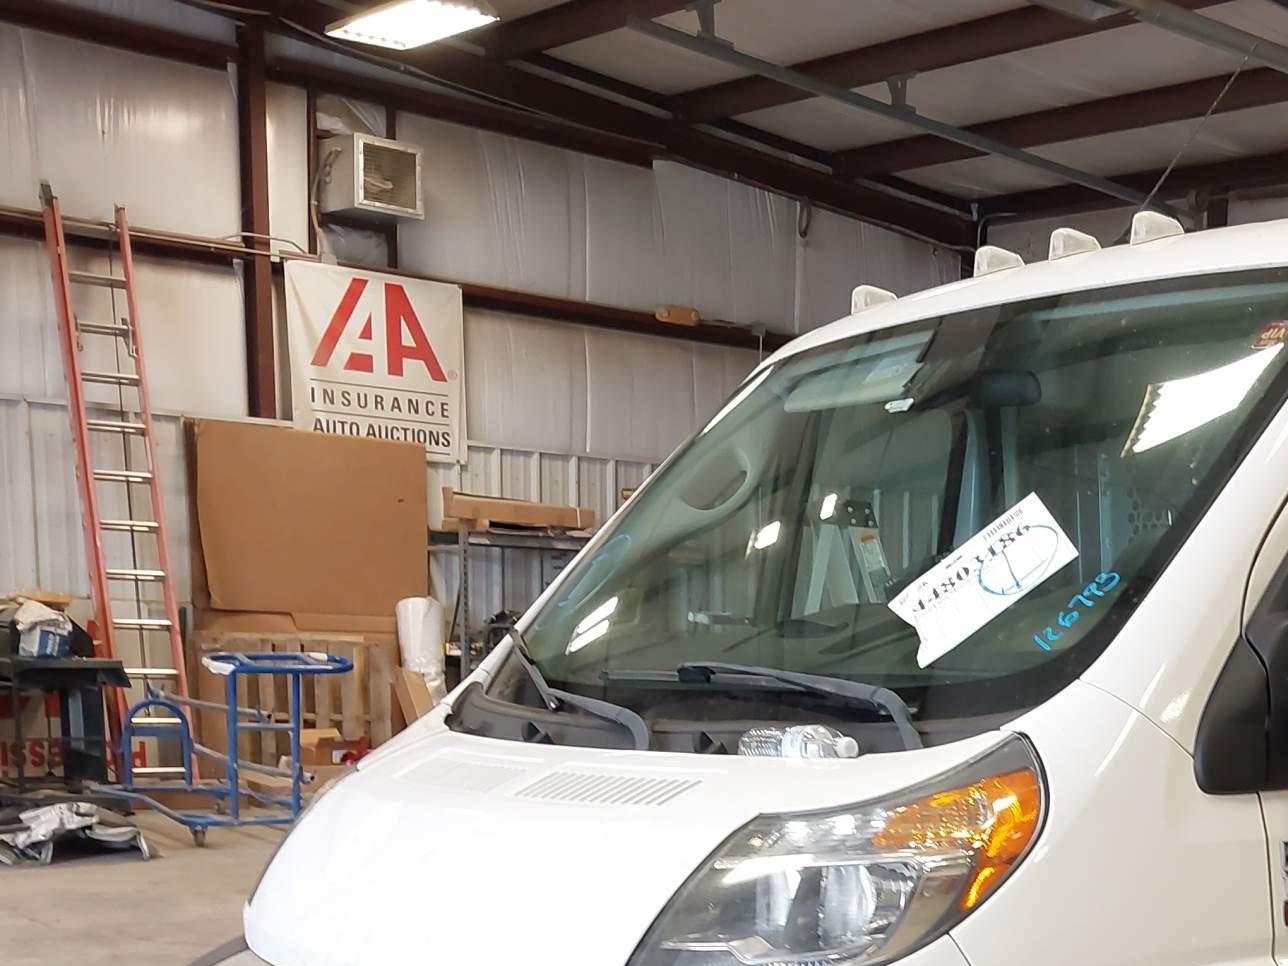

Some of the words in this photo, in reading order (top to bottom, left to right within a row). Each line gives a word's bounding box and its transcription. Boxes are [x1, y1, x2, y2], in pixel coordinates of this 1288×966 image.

[310, 277, 448, 383] IAA
[310, 386, 449, 418] INSURANCE
[313, 417, 360, 437] AUTO
[366, 423, 451, 448] AUCTIONS
